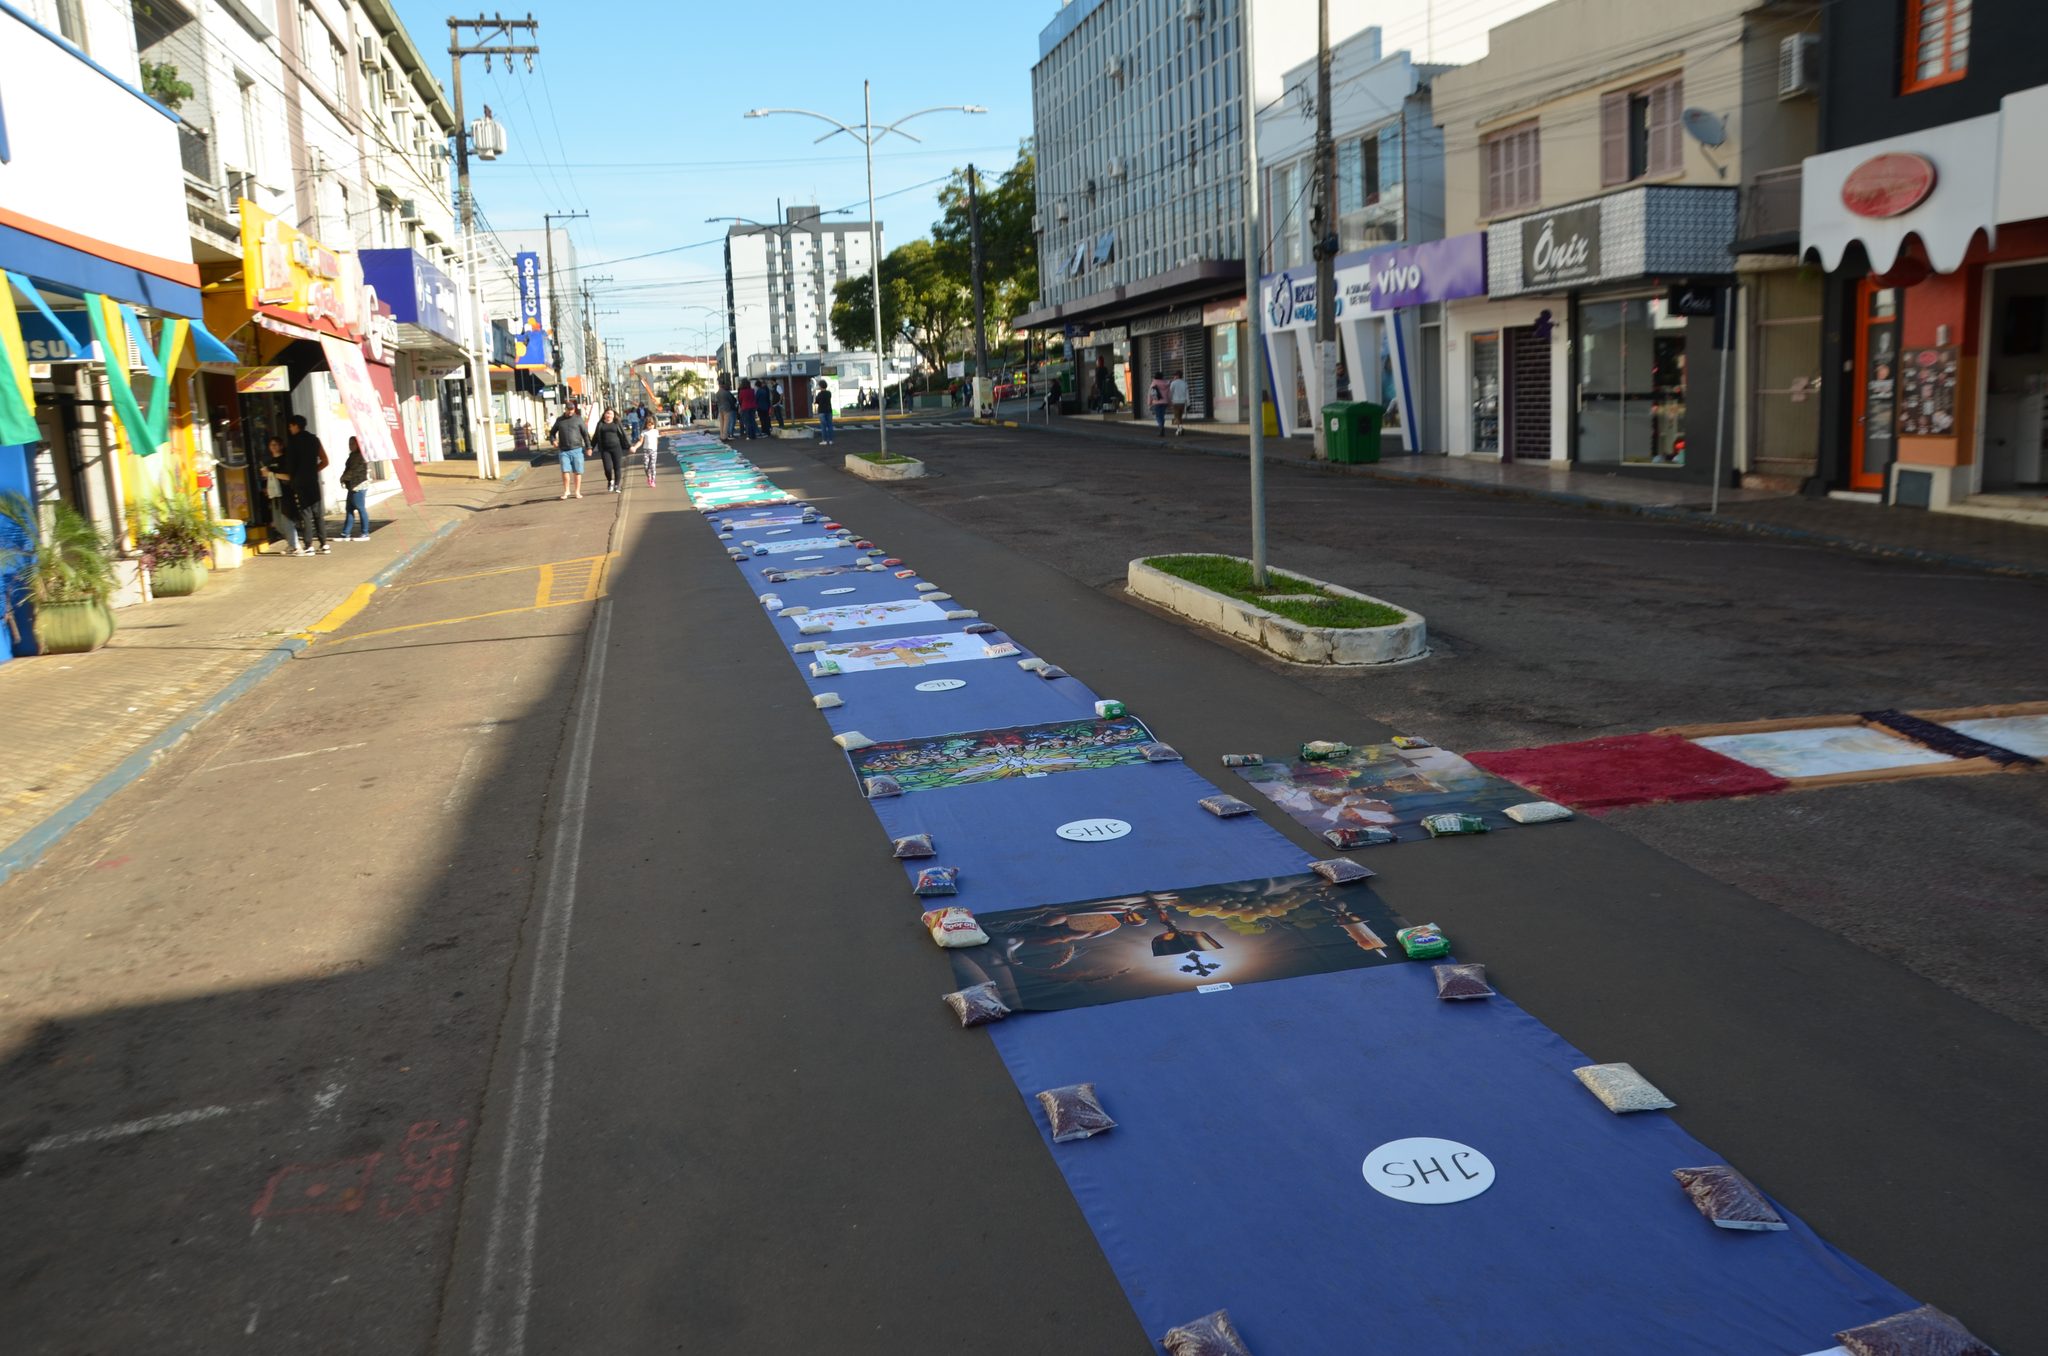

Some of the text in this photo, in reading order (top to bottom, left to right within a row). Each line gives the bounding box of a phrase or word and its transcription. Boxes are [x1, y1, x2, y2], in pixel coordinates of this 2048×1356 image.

[1533, 218, 1589, 271] Ônix
[523, 257, 537, 317] Colombo
[1377, 257, 1421, 295] vivo
